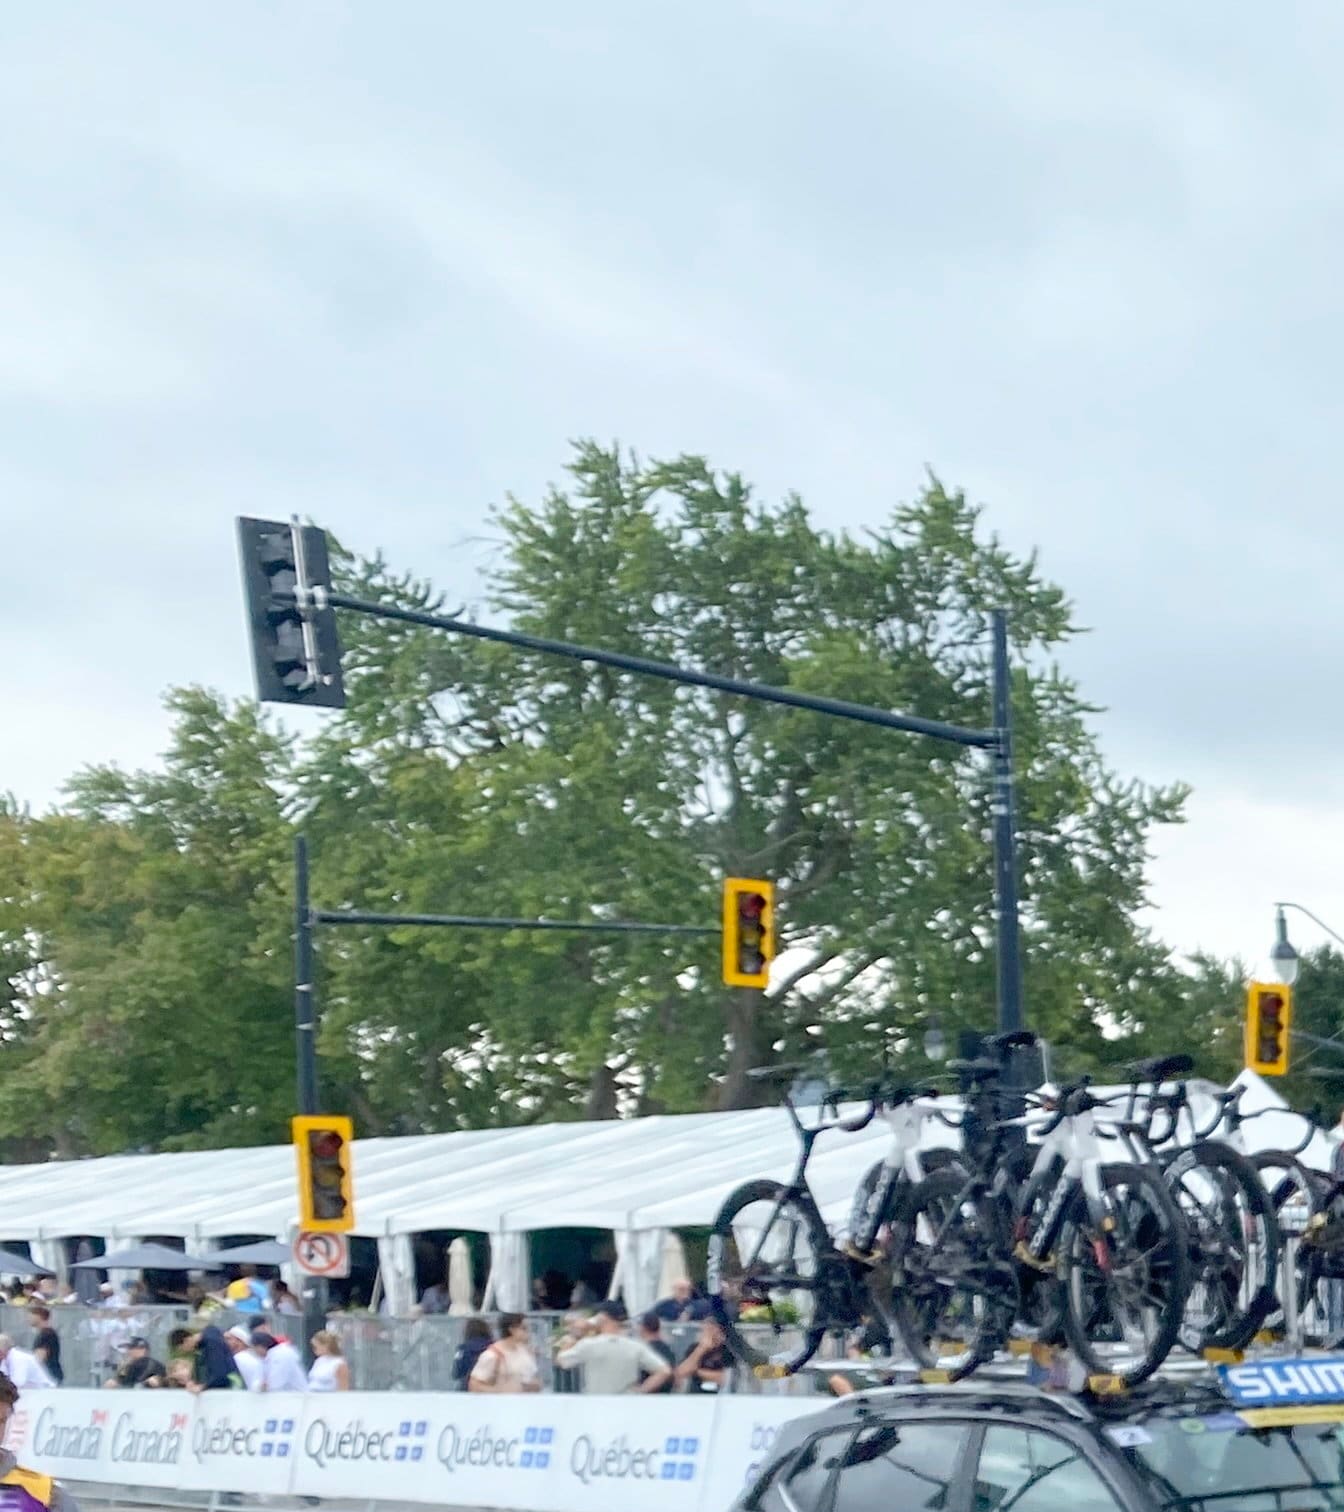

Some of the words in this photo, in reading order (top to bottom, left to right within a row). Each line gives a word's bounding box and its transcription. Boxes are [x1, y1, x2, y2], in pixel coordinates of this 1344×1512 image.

[33, 1406, 103, 1460] Canada
[112, 1411, 183, 1464] Canada
[192, 1416, 260, 1464] Québec
[304, 1419, 395, 1468] Québec
[437, 1424, 519, 1472] Québec
[570, 1432, 660, 1484] Québec
